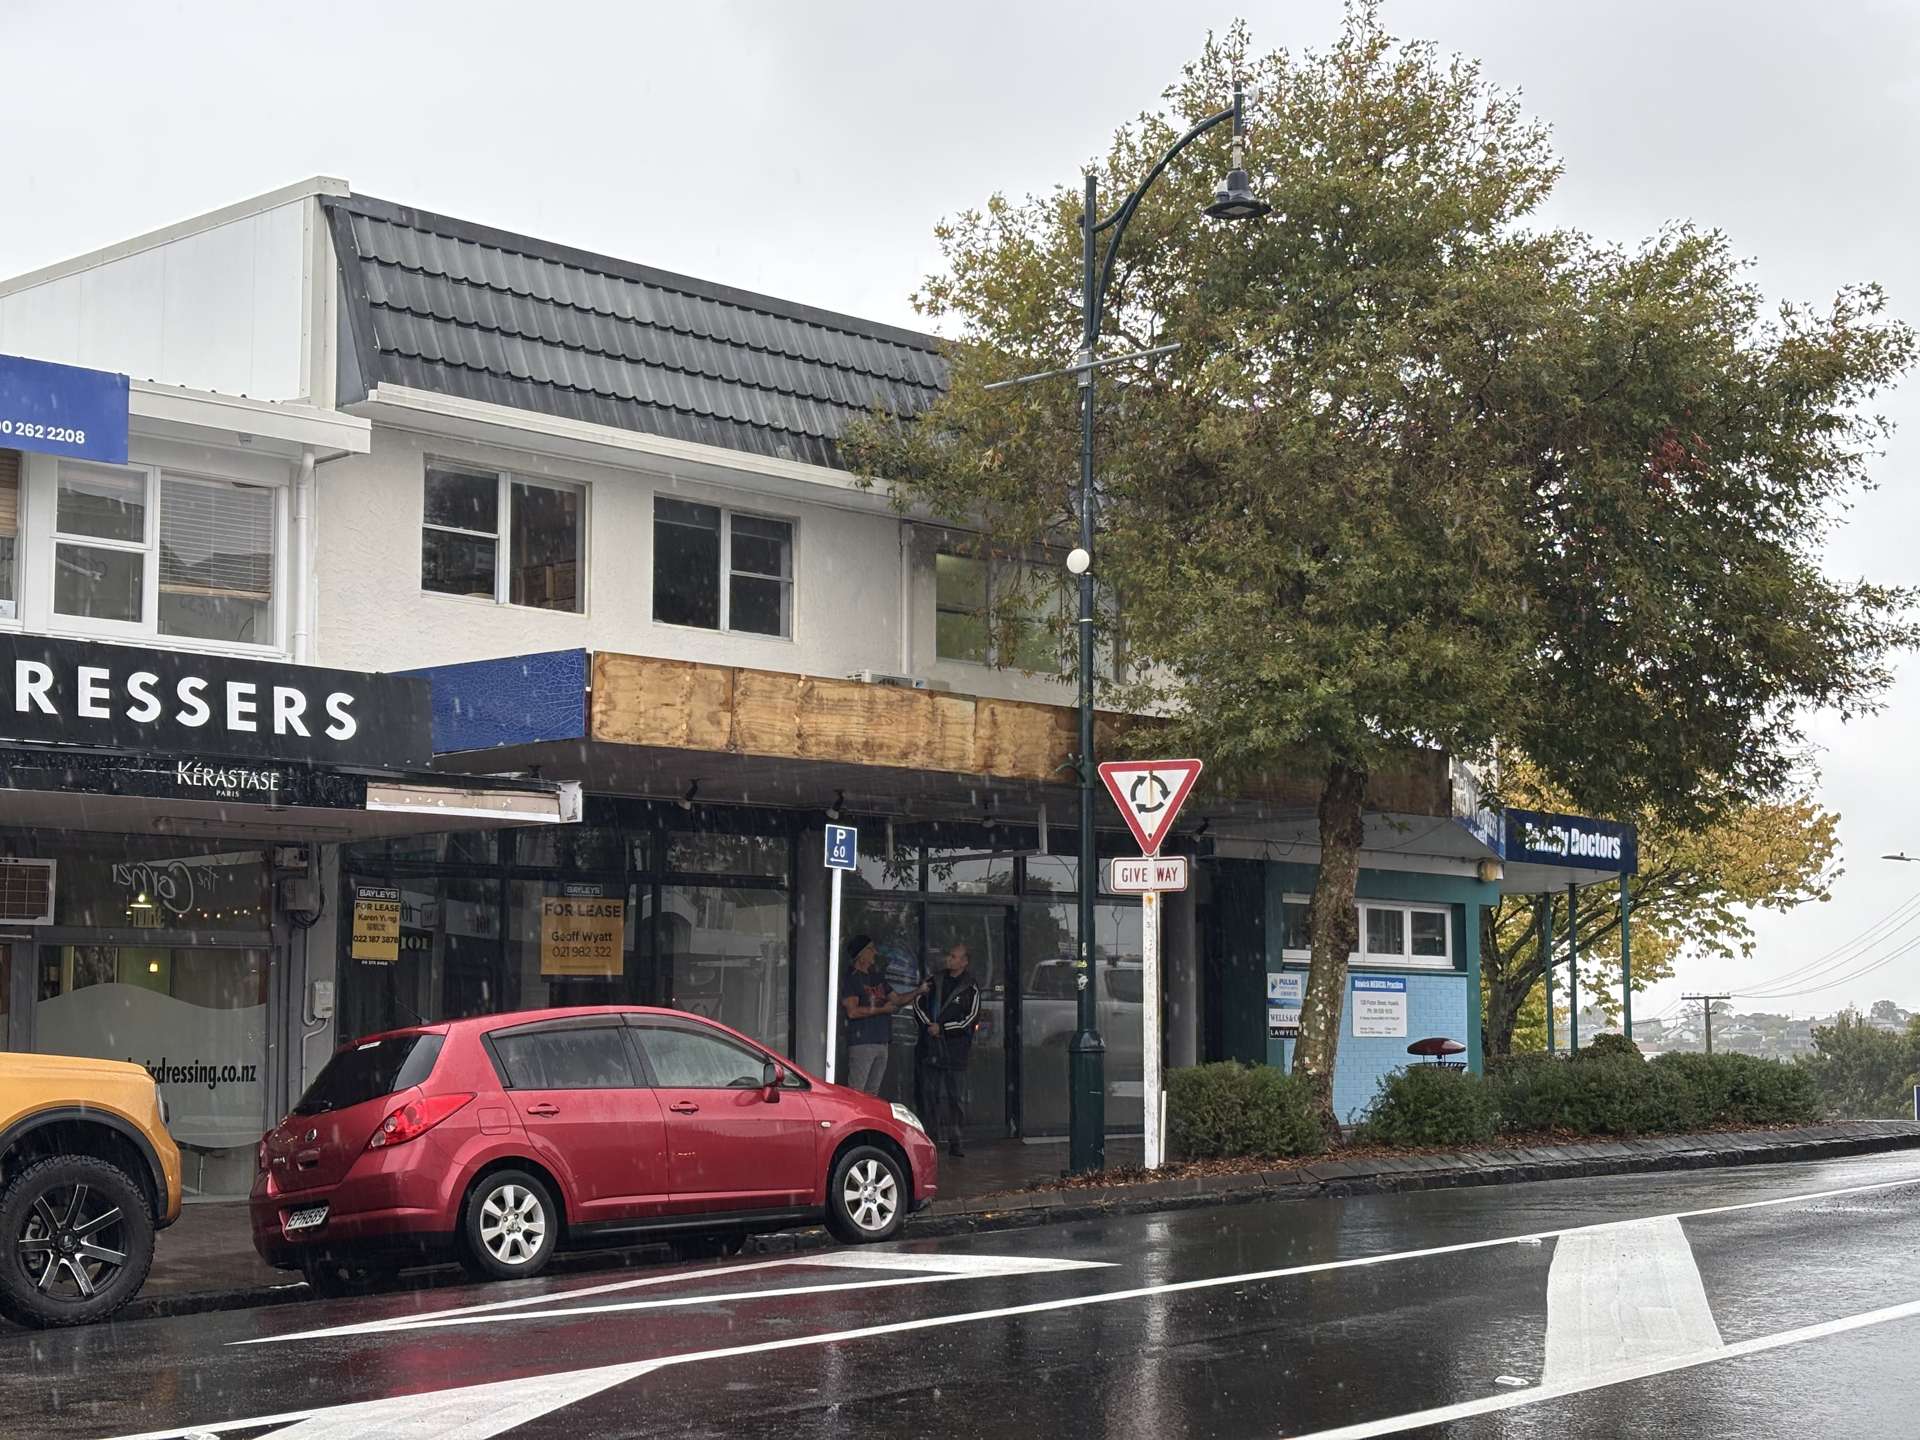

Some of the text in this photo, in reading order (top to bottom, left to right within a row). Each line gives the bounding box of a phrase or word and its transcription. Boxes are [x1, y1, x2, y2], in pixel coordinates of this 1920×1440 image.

[0, 420, 86, 445] 0 262 2208
[15, 659, 357, 741] RESSERS
[177, 760, 280, 791] KÉRASTASE
[215, 789, 240, 798] PARIS
[836, 829, 846, 844] P
[1570, 827, 1622, 860] Doctors
[833, 845, 846, 858] 60
[1121, 867, 1178, 883] GIVE WAY
[359, 889, 397, 898] BAYLEYS
[355, 903, 400, 912] FOR LEASE
[544, 903, 622, 917] FOR LEASE
[582, 932, 613, 943] Wyatt
[551, 946, 612, 957] 021 982 322
[127, 1057, 257, 1090] irdressing.co.nz
